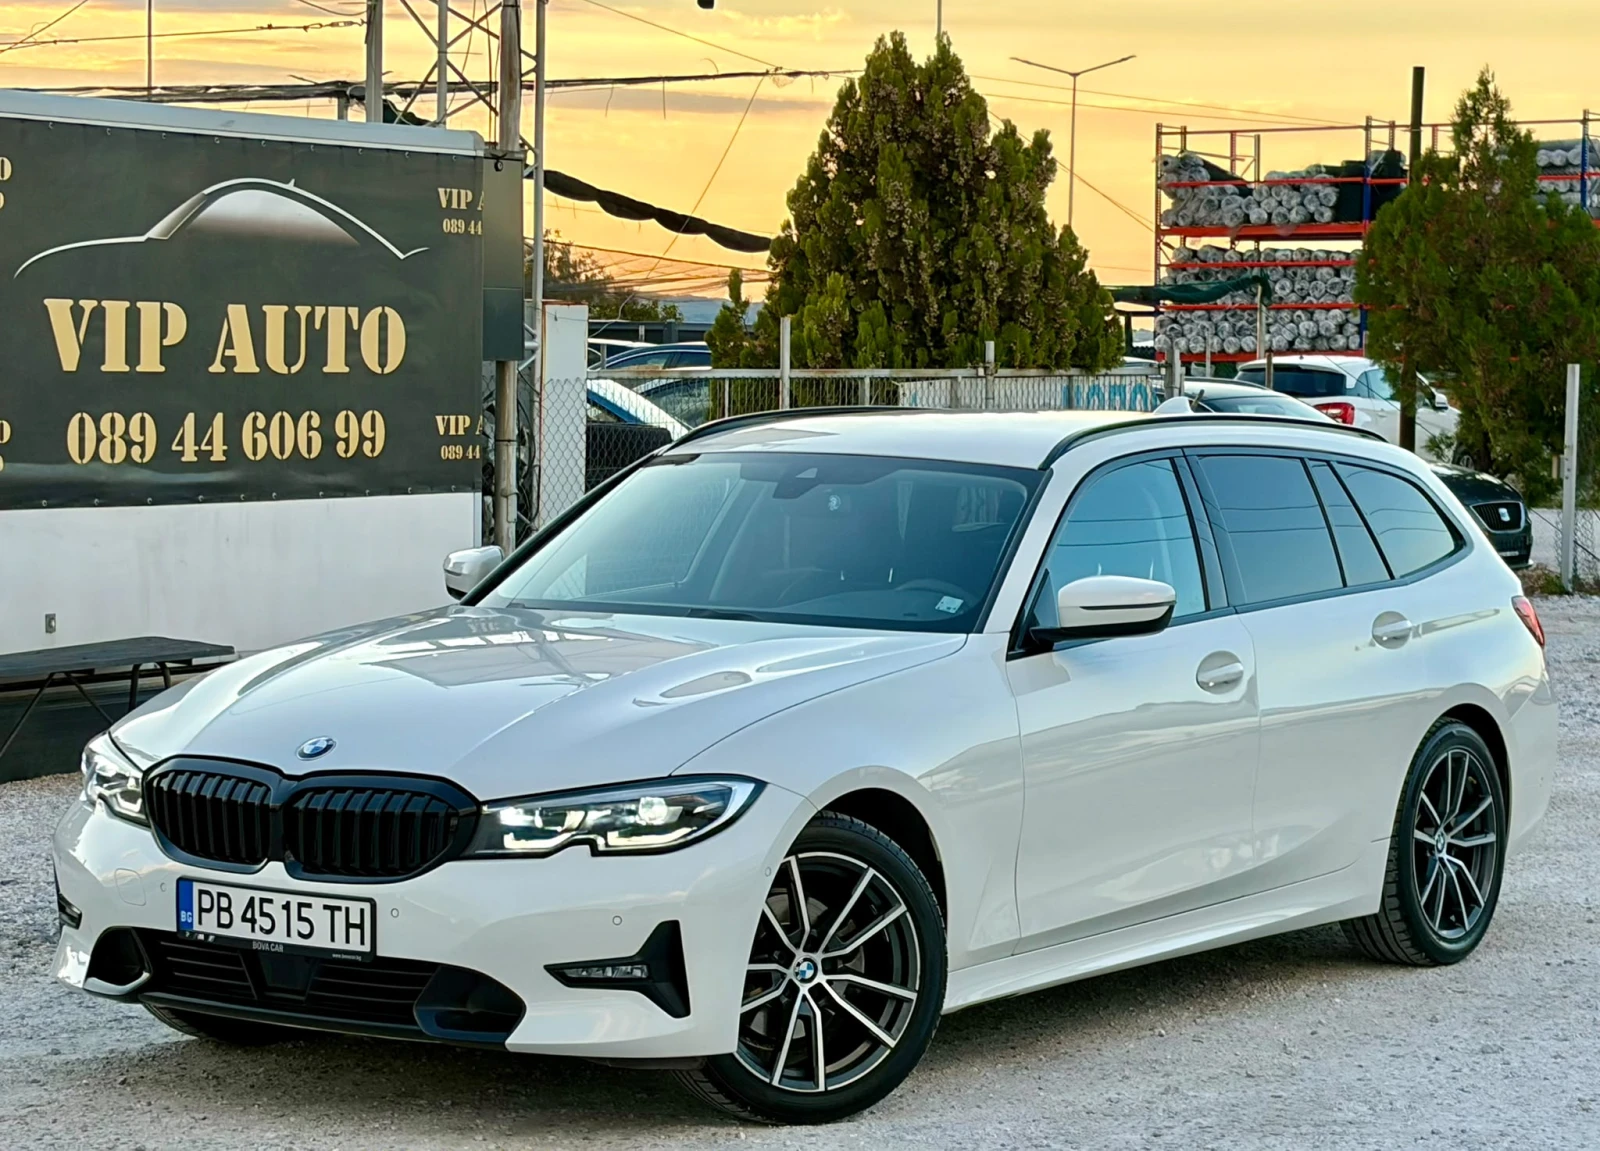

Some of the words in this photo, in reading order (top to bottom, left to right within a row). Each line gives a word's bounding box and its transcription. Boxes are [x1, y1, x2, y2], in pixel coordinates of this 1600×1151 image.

[437, 187, 473, 210] VIP
[442, 218, 465, 234] 089
[467, 219, 482, 235] 44
[44, 299, 186, 372] VIP
[208, 304, 406, 374] AUTO
[435, 414, 471, 436] VIP
[67, 411, 156, 464] 089
[172, 412, 227, 462] 44
[242, 410, 322, 461] 606
[335, 409, 386, 458] 99
[440, 444, 464, 460] 089
[465, 444, 481, 460] 44
[180, 910, 193, 923] BG
[197, 888, 234, 930] PB
[240, 895, 315, 940] 4515
[322, 903, 366, 946] TH
[252, 941, 270, 951] BOVA
[270, 943, 284, 953] CAR
